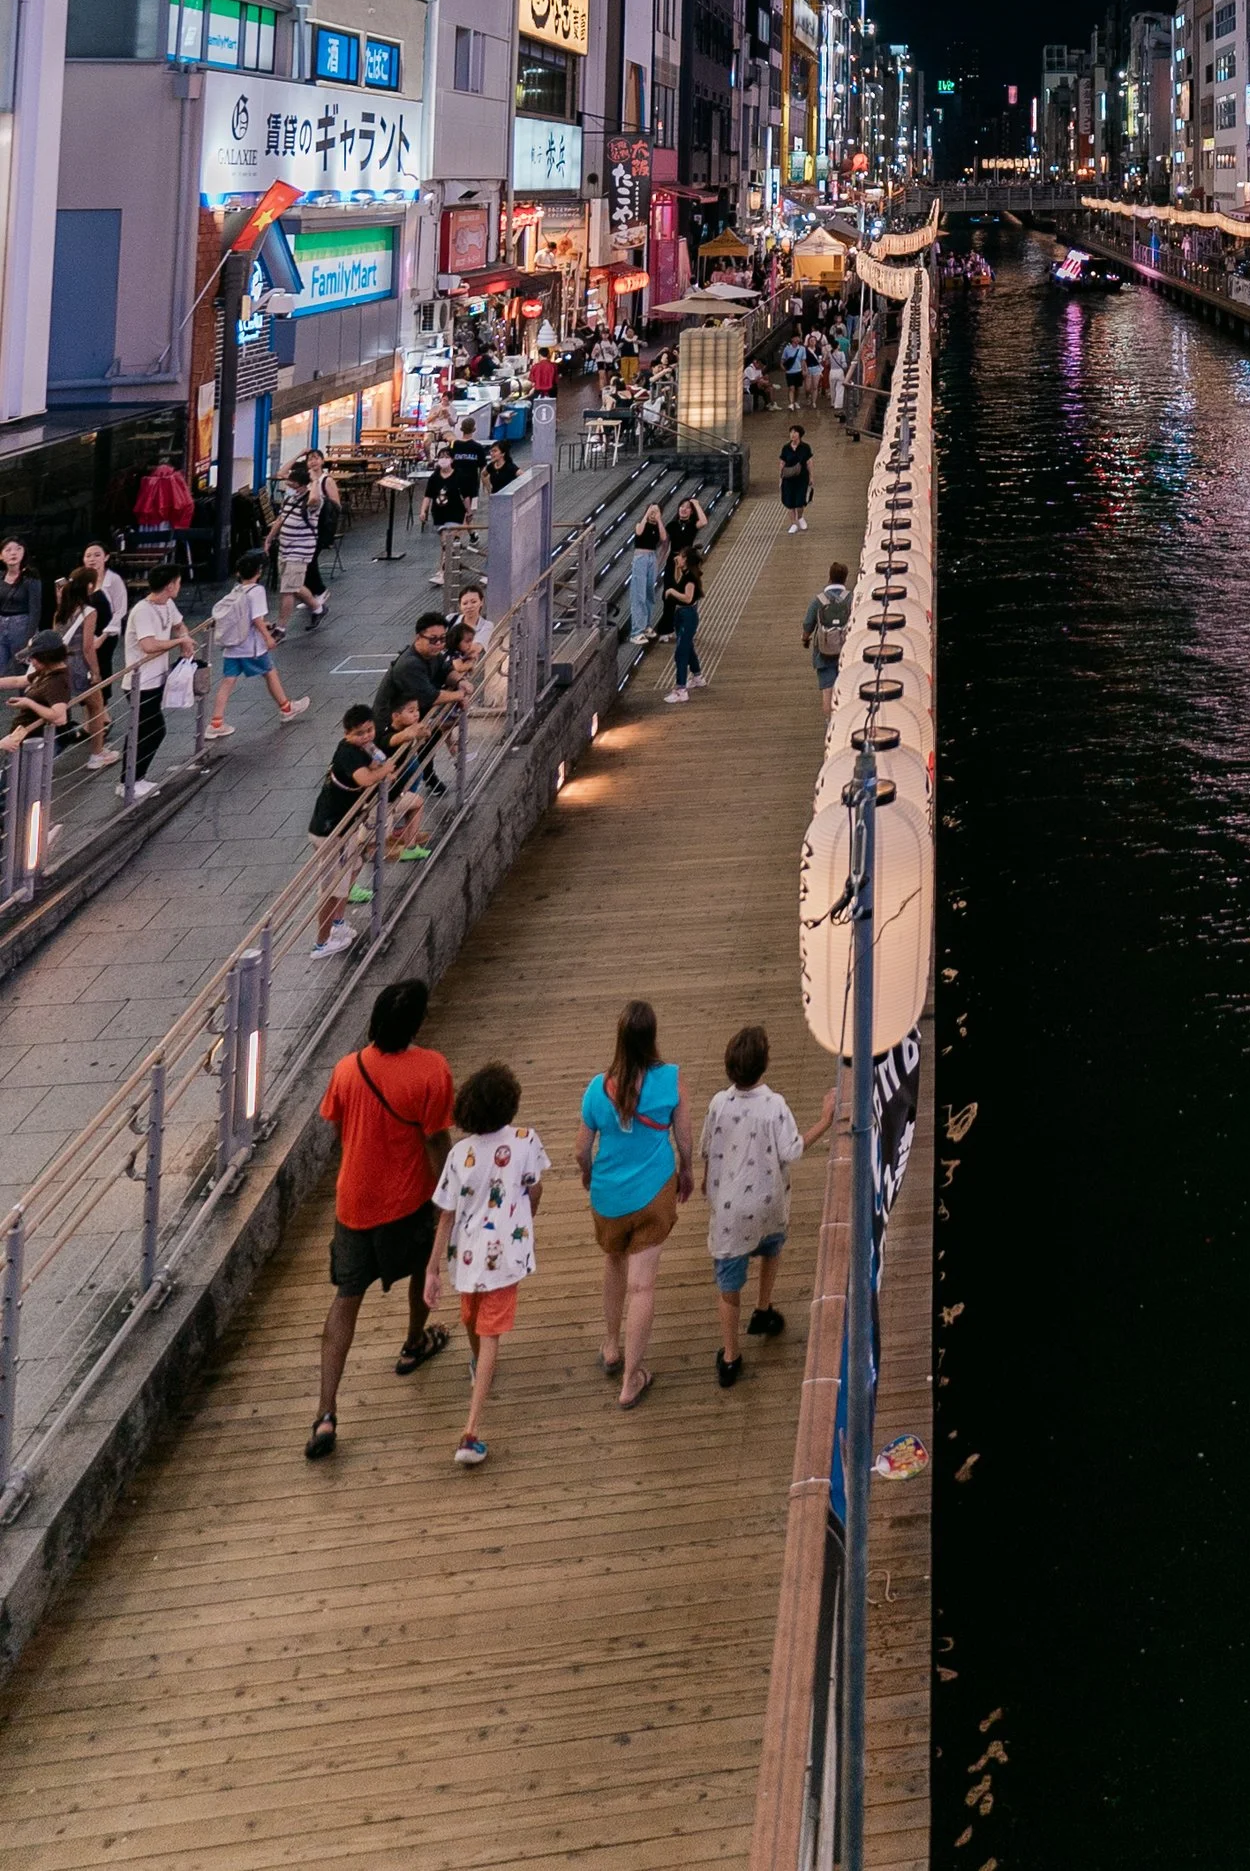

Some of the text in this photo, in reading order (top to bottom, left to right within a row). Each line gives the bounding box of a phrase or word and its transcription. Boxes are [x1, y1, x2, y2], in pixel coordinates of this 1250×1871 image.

[327, 37, 340, 74] 酒
[364, 46, 389, 81] たばこ
[264, 103, 410, 172] 賃貸のギャラント
[218, 148, 258, 166] GALAXIE
[631, 139, 650, 177] 大阪
[612, 163, 634, 244] たこやき
[311, 259, 378, 298] FamilyMart
